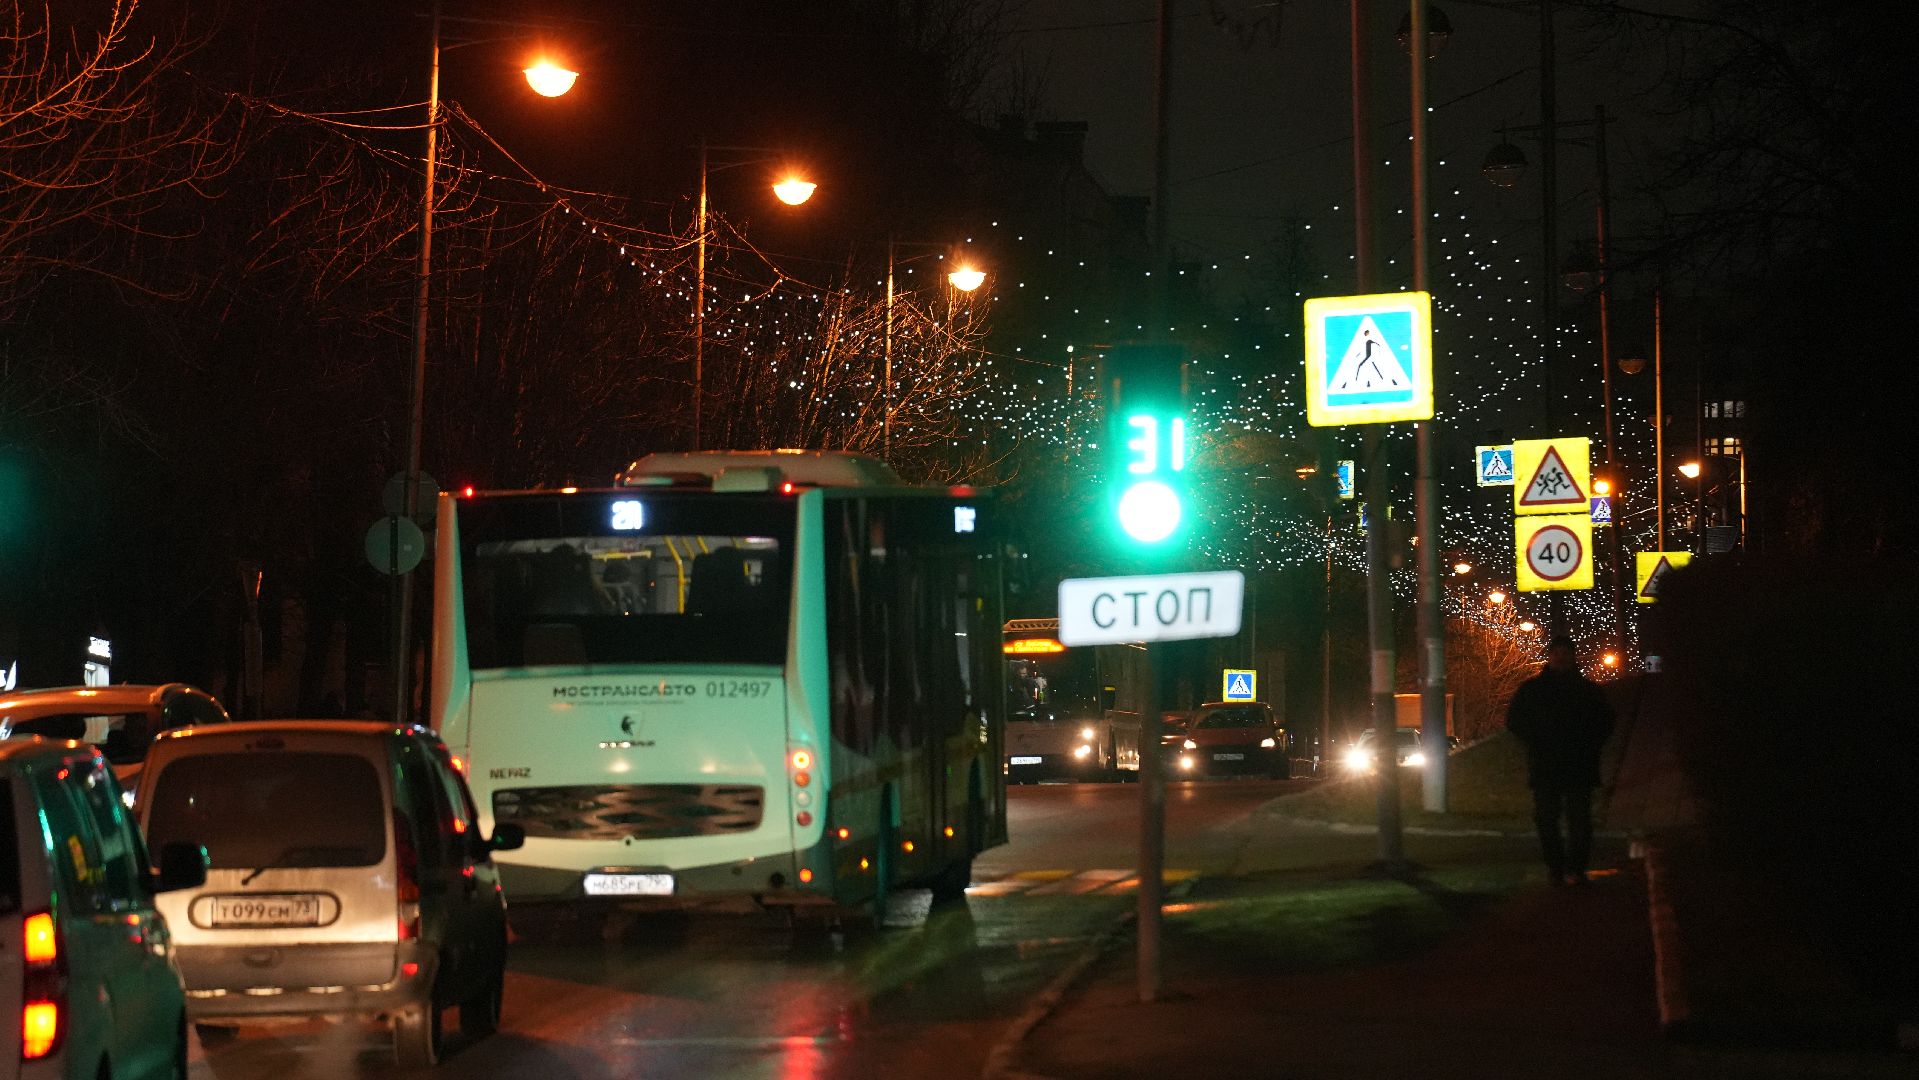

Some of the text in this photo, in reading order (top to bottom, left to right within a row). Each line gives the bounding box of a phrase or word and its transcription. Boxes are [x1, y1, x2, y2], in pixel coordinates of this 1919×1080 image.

[1128, 415, 1185, 474] 31
[1538, 541, 1571, 564] 40
[1092, 588, 1211, 629] СТОП
[553, 680, 772, 699] МОСТРАНСАВТО 012497
